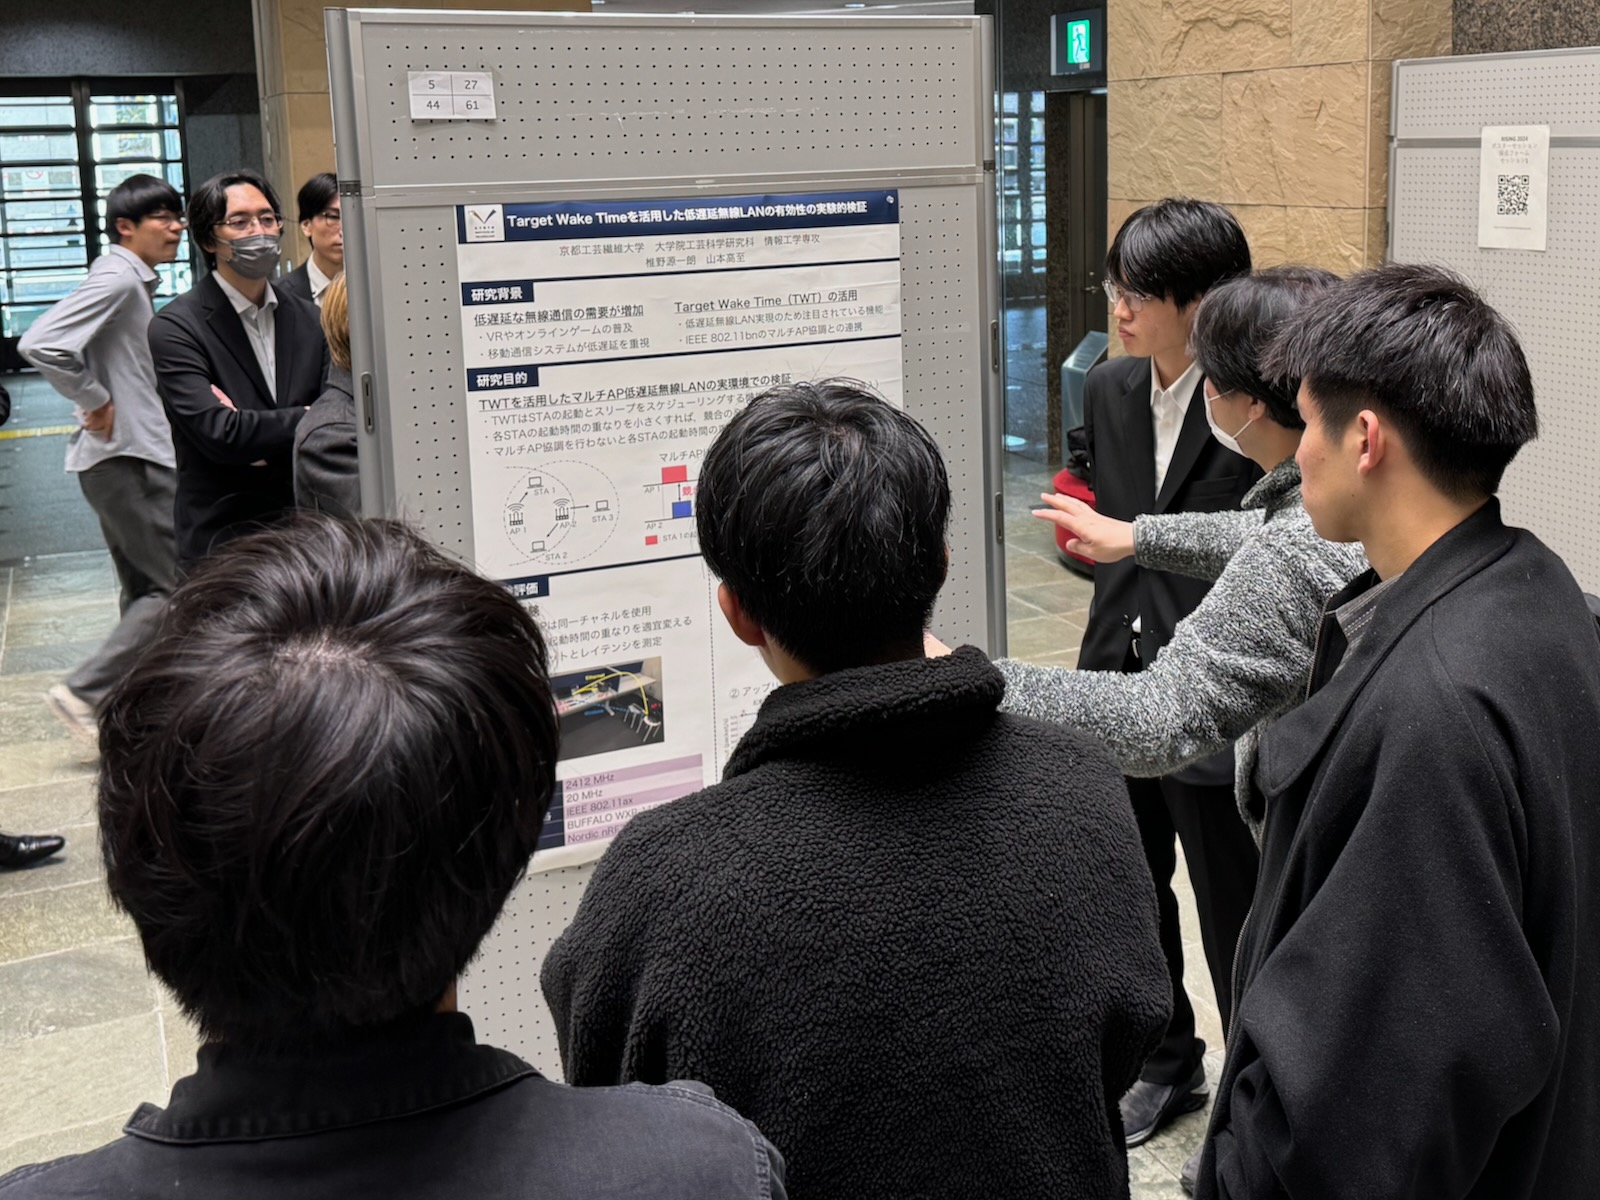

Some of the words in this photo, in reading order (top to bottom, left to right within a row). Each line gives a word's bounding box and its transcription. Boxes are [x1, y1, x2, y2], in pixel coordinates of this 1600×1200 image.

[428, 79, 436, 90] 5
[464, 79, 478, 90] 27
[426, 100, 441, 110] 44
[465, 100, 480, 110] 61
[507, 214, 554, 230] Target
[557, 212, 593, 226] Wake
[471, 286, 523, 302] 研究背景
[674, 301, 715, 314] Target
[718, 298, 751, 309] Wake
[474, 304, 644, 326] 低遅延な無線通信の需要が増加
[685, 333, 708, 345] IEEE
[476, 371, 528, 387] 研究目的
[534, 487, 550, 496] STA
[559, 521, 571, 529] AP
[592, 514, 607, 523] STA
[510, 527, 521, 535] AP
[545, 553, 561, 561] STA
[566, 777, 591, 790] 2412
[593, 773, 615, 784] MHz
[566, 792, 579, 803] 20
[581, 789, 603, 800] MHz
[566, 805, 588, 816] IEEE
[590, 797, 634, 812] 802.11ax
[567, 813, 613, 830] BUFFALO
[567, 831, 599, 844] Nordic
